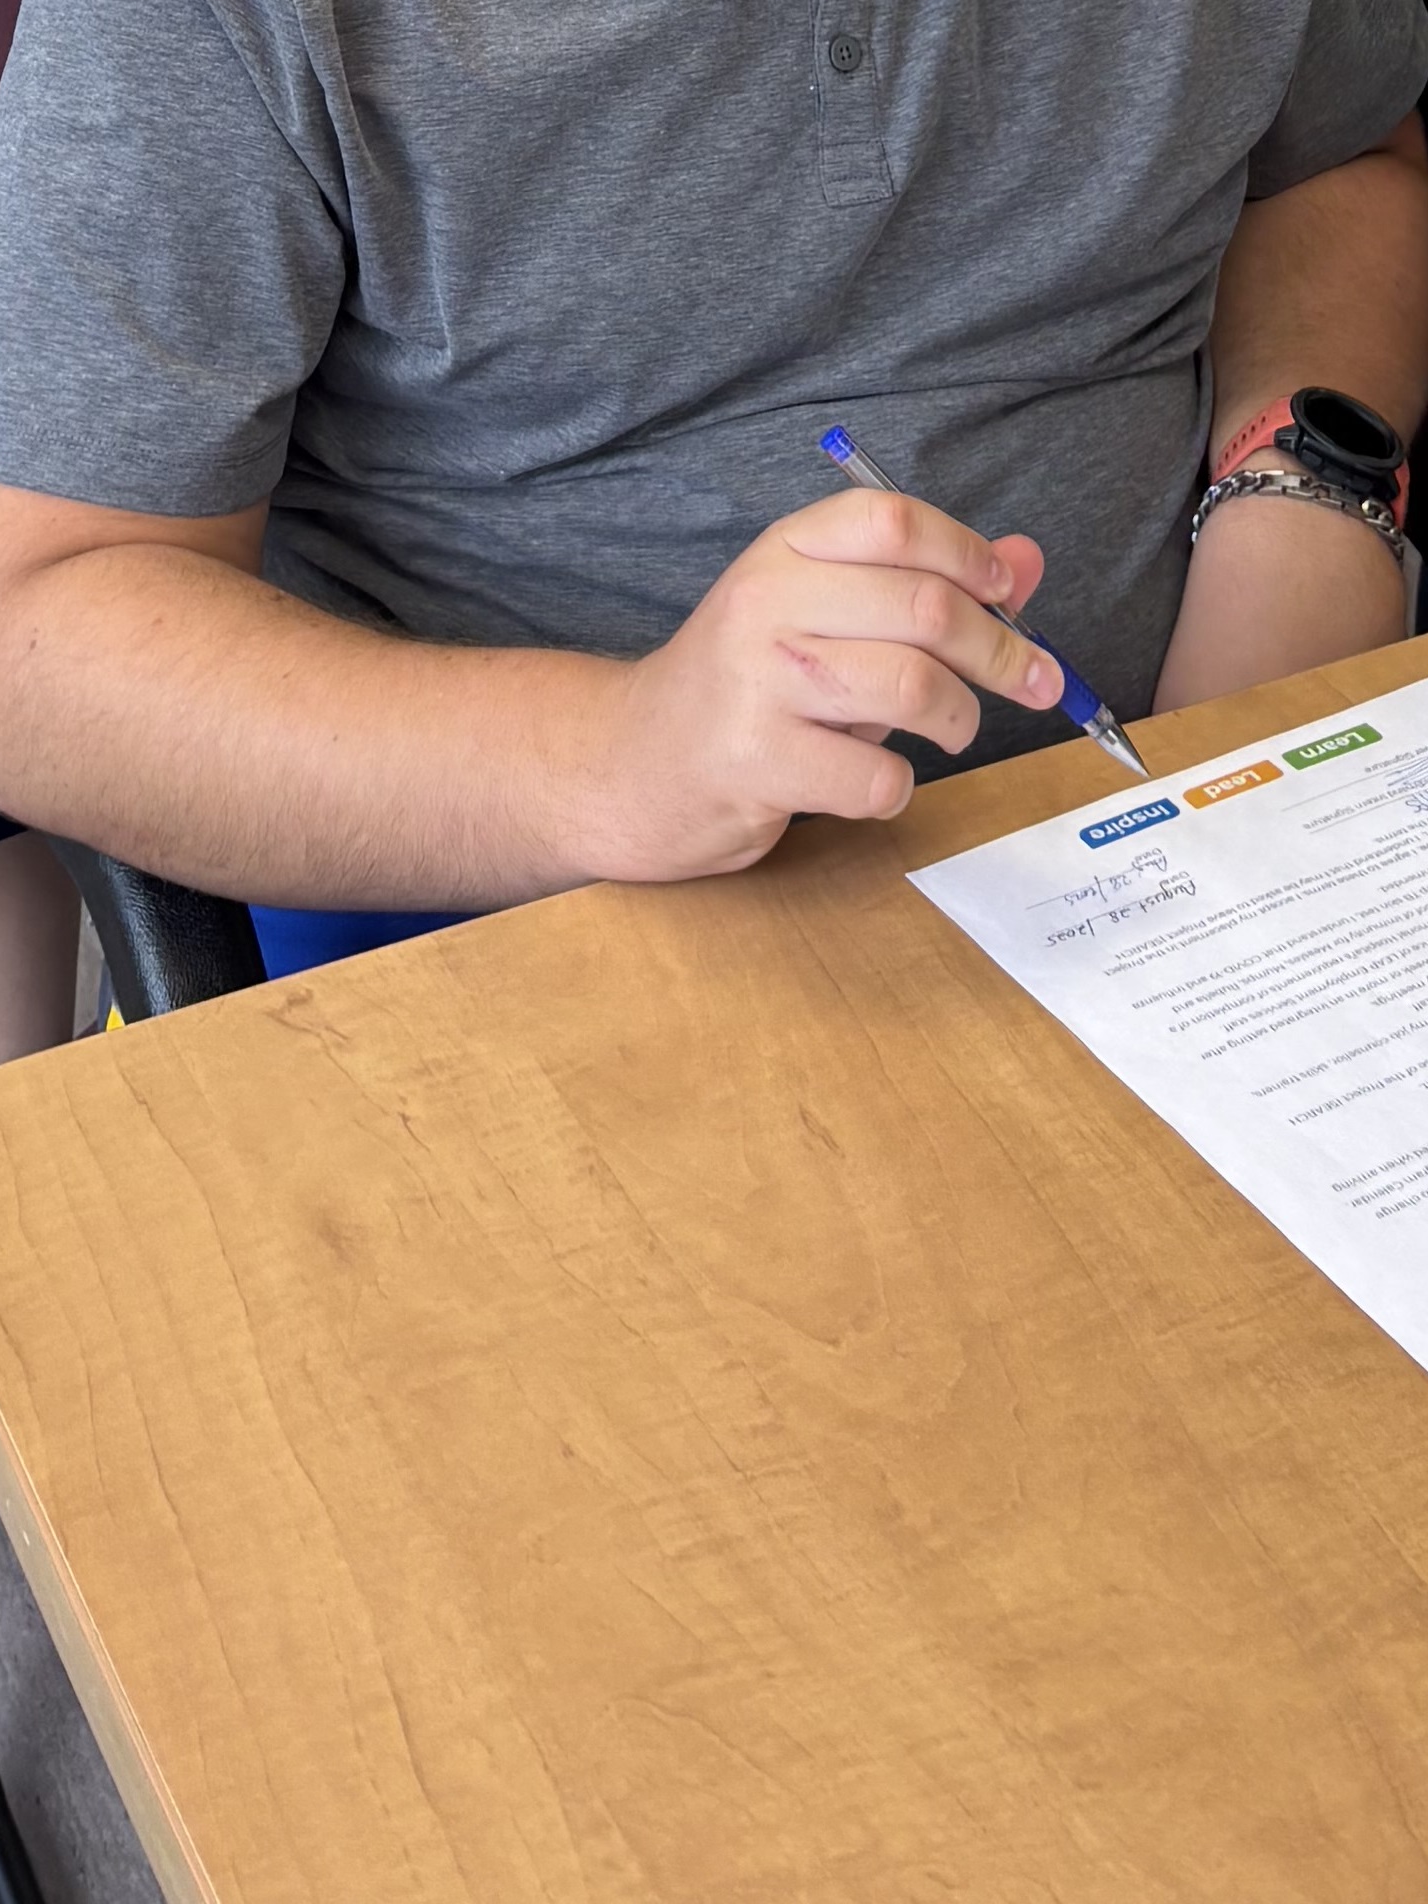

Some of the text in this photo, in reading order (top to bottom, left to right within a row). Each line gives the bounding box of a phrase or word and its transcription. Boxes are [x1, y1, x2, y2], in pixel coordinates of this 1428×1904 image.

[1299, 731, 1364, 758] Learn
[1203, 770, 1260, 798] Lead
[1089, 804, 1169, 838] Inspire
[1134, 874, 1195, 912] August
[1046, 918, 1094, 946] /2025
